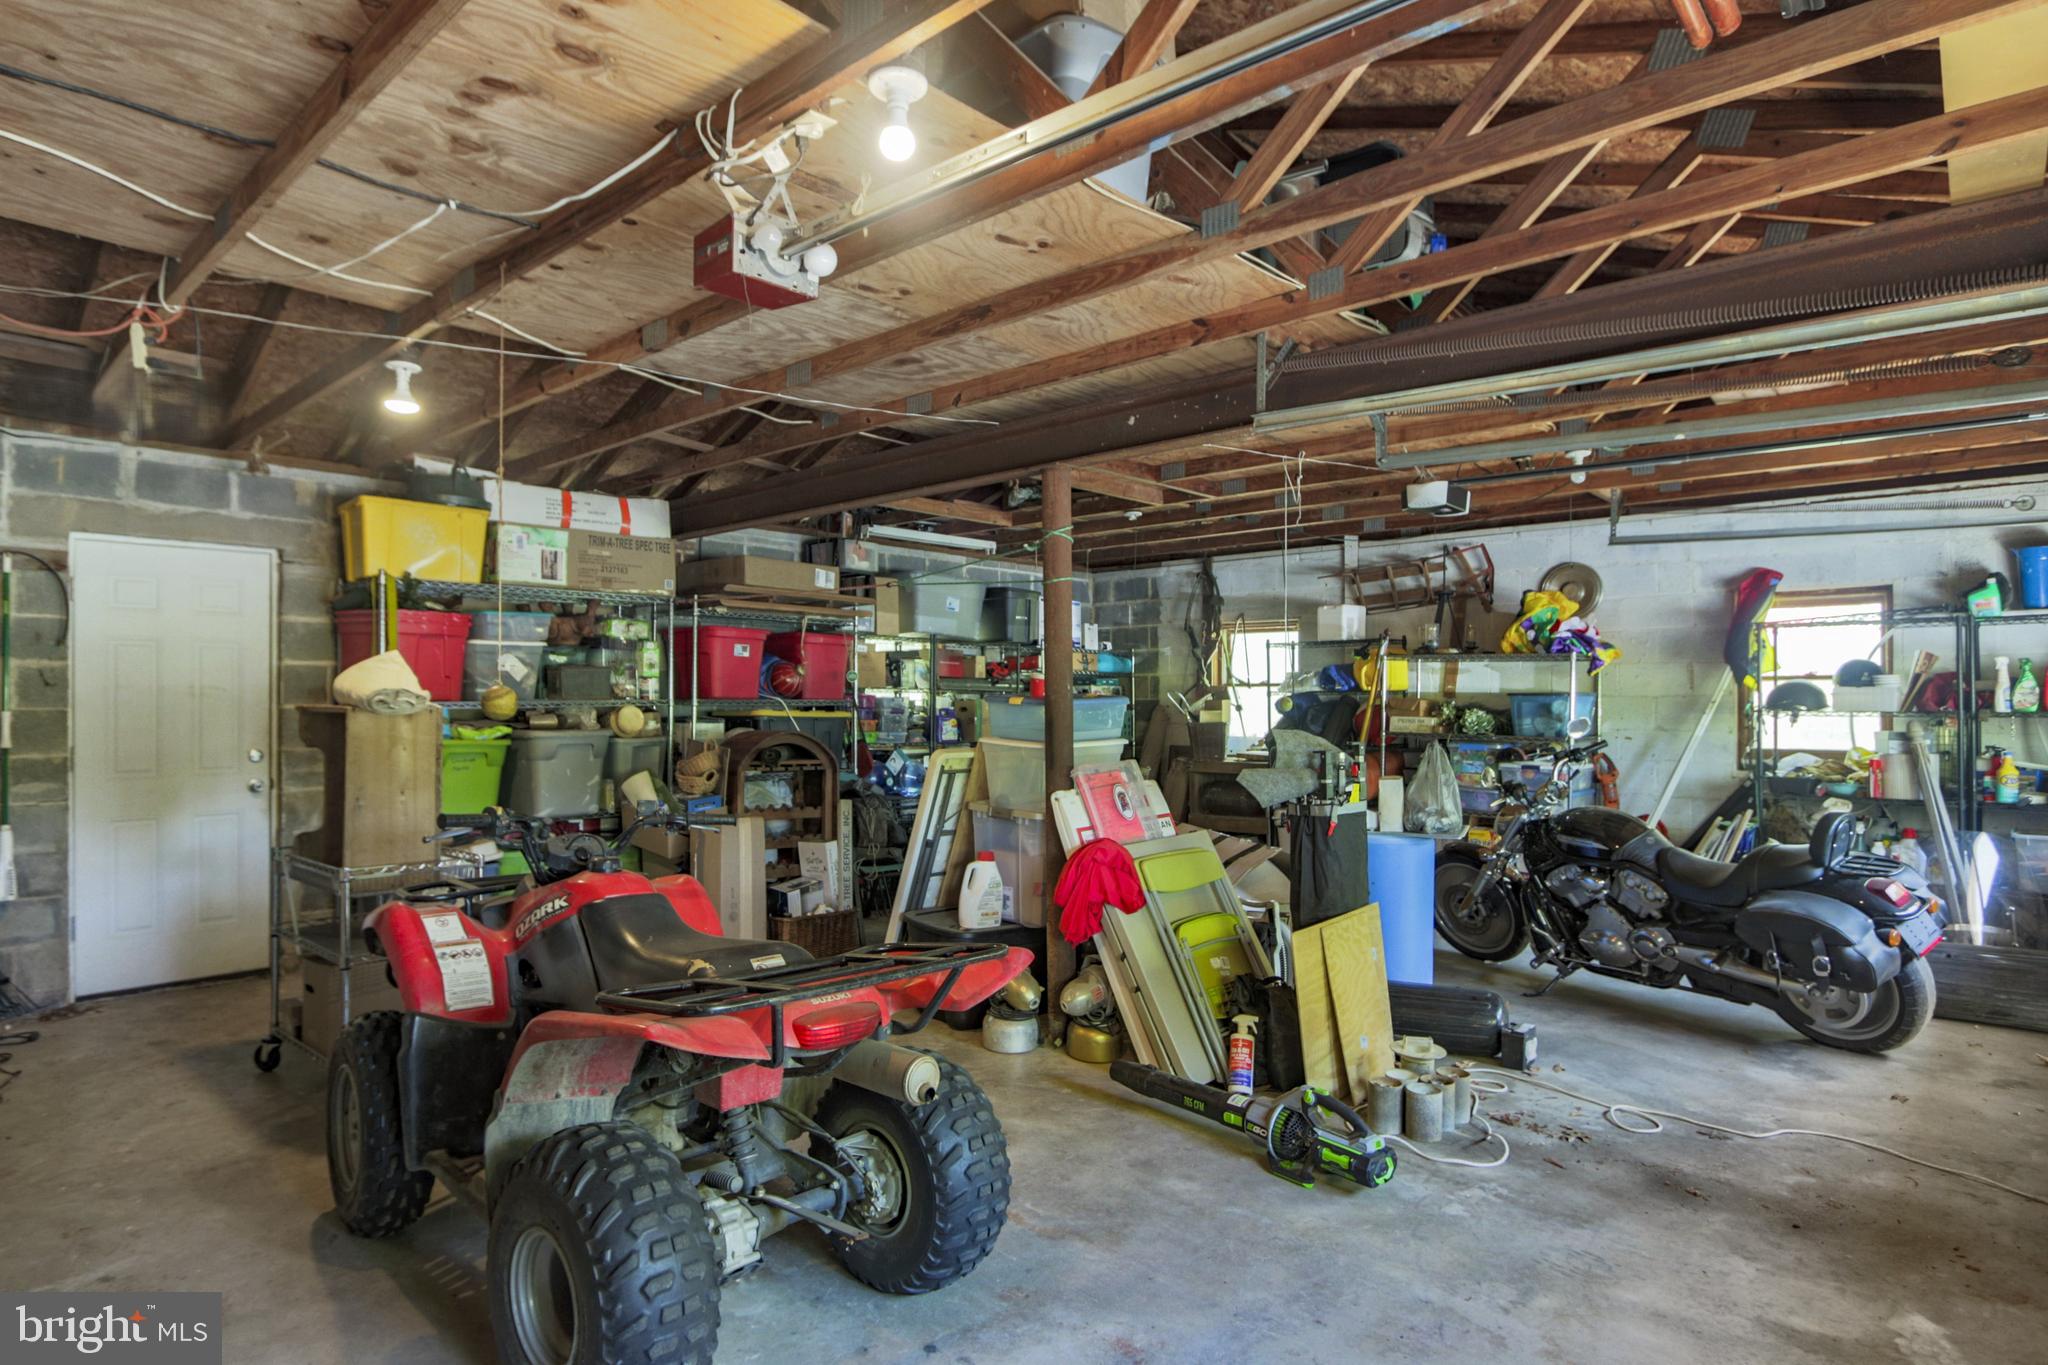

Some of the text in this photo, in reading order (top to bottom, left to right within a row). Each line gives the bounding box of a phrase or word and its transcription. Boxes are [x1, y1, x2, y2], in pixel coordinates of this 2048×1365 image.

[588, 535, 671, 554] TRIM-A-TREE SPEC TREE
[843, 877, 851, 900] TREE
[516, 895, 569, 939] OZARK
[810, 992, 852, 1005] SUZUKI
[1247, 1122, 1268, 1137] EGO
